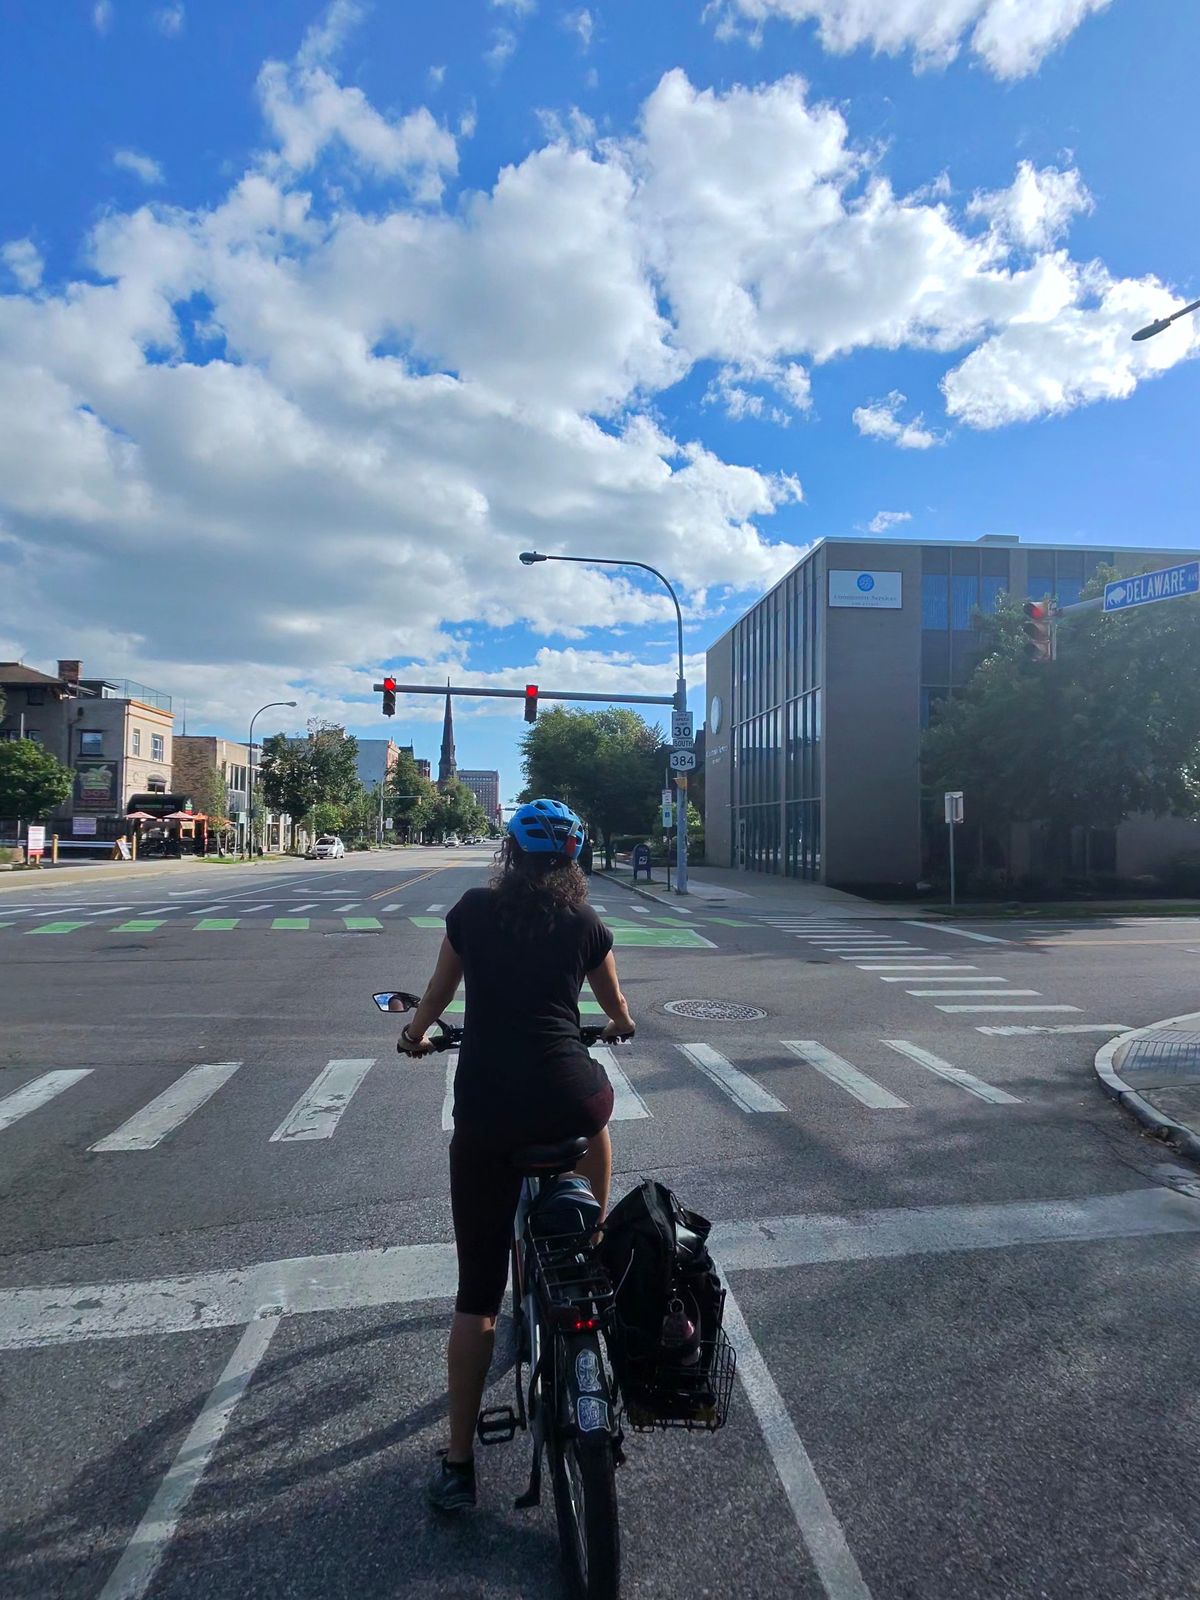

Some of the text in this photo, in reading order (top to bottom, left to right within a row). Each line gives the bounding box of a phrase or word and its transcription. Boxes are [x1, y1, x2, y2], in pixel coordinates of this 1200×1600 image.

[1126, 569, 1186, 603] DELAWARE
[674, 726, 691, 737] 30
[672, 756, 694, 766] 384
